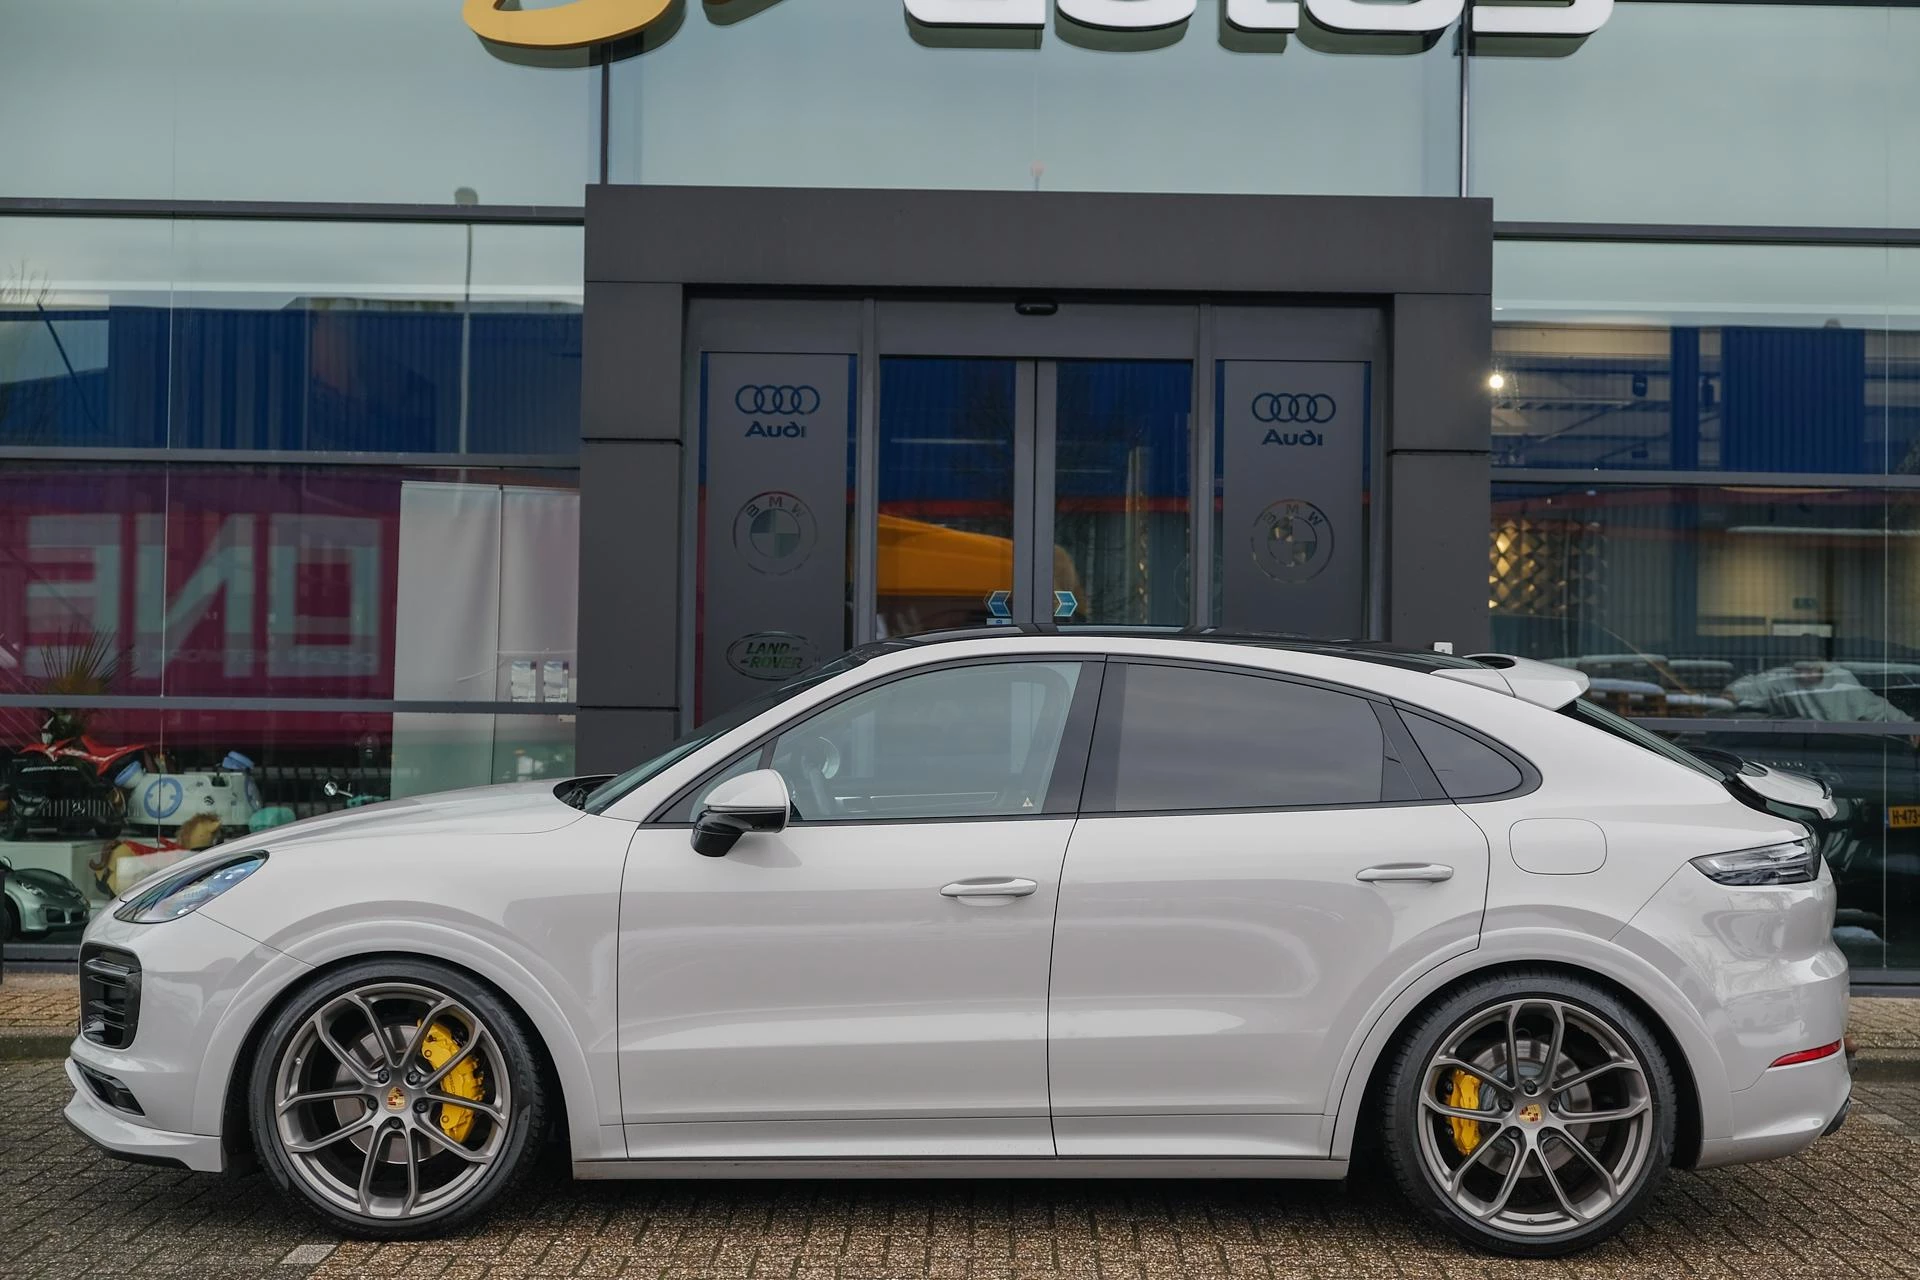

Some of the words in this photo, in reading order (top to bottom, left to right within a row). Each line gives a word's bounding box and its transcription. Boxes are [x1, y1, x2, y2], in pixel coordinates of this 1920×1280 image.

[745, 421, 806, 438] Audi
[1262, 429, 1323, 446] Audi
[1262, 503, 1323, 527] BMW
[746, 642, 790, 654] LAND
[749, 656, 803, 668] ROVER
